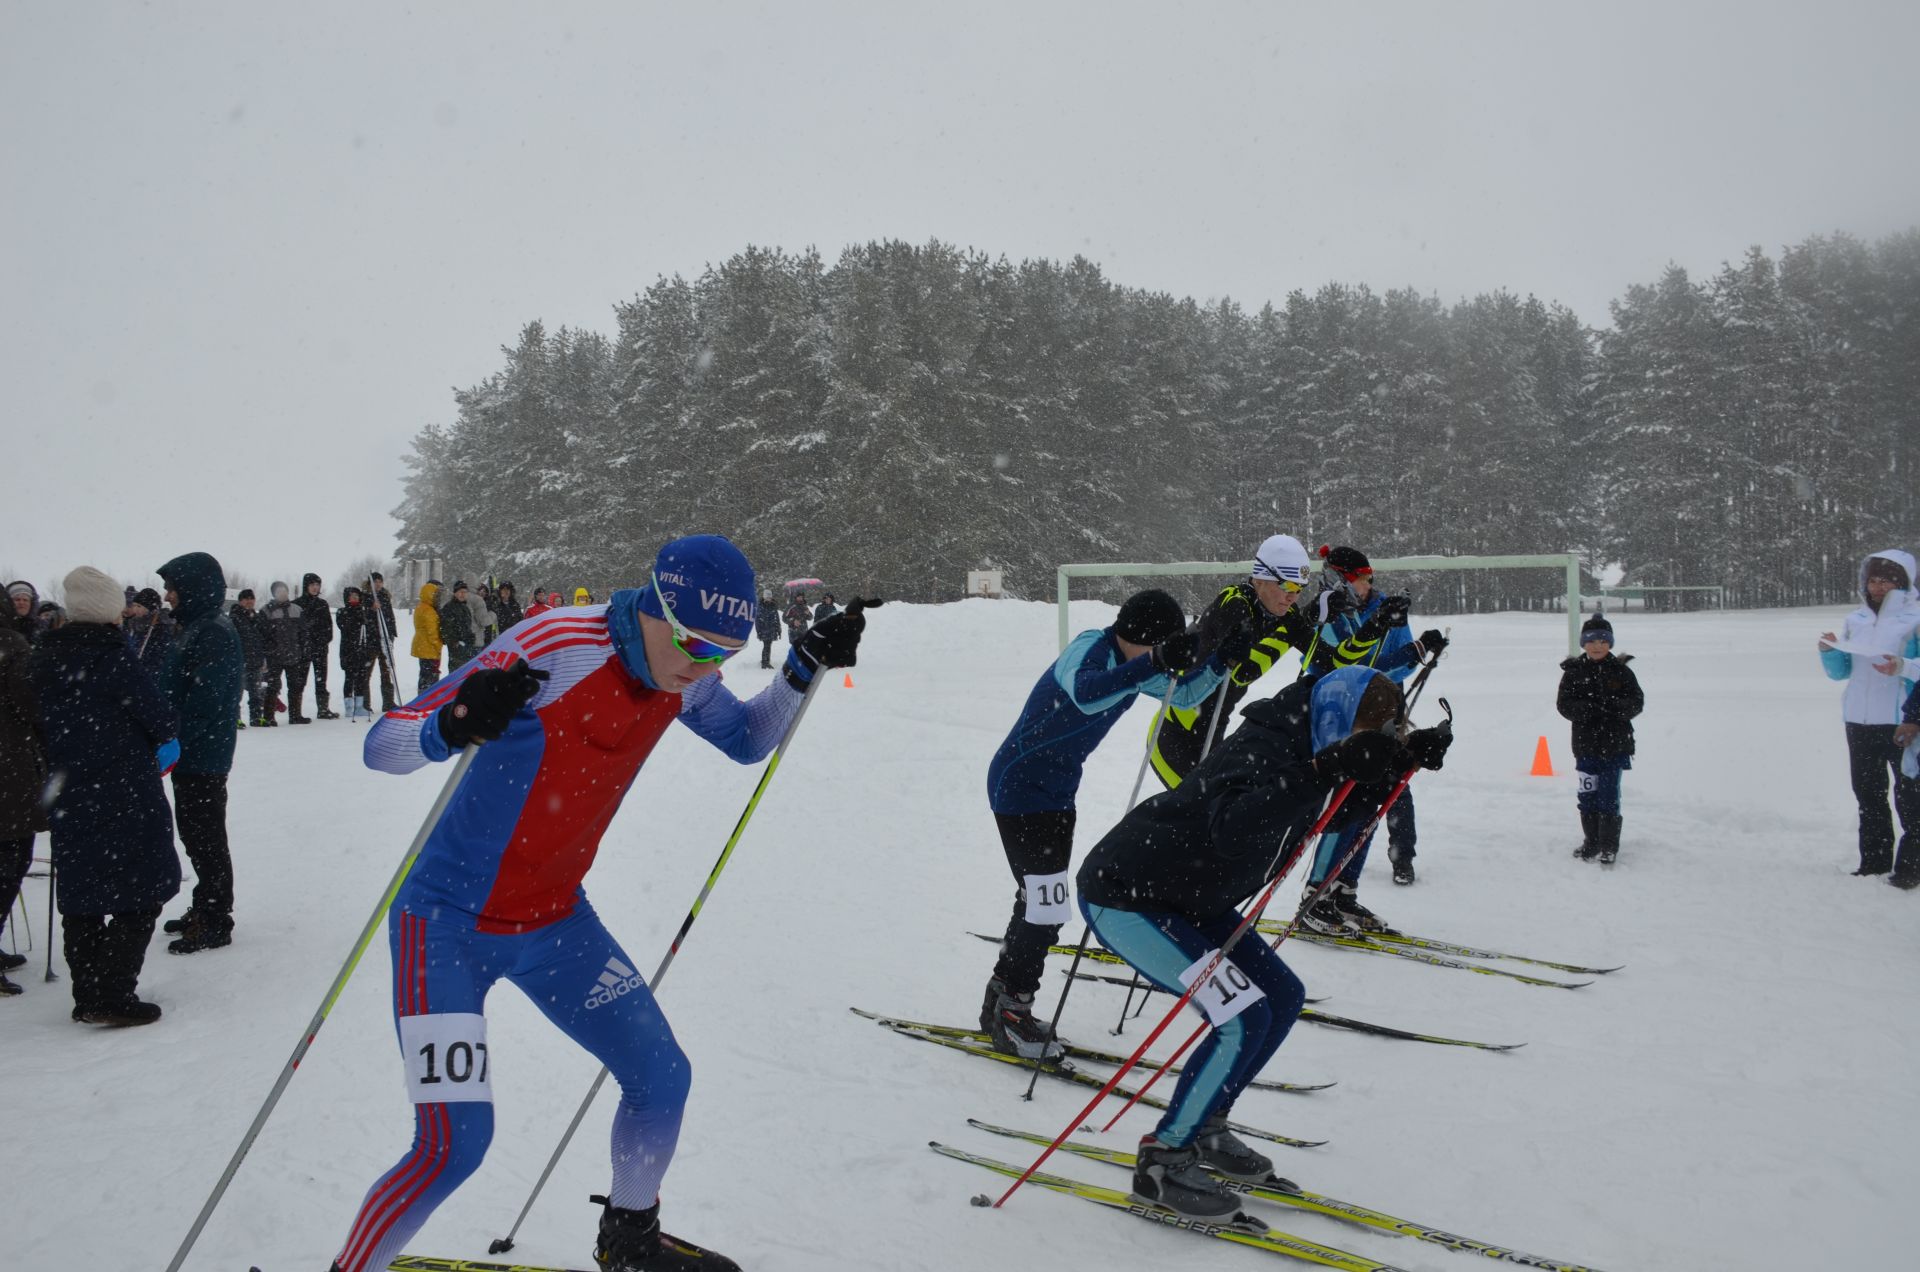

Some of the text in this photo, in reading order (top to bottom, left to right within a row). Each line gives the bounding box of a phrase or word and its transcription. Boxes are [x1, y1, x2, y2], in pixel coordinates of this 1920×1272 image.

[660, 571, 687, 587] VITAL
[1037, 882, 1069, 906] 10
[584, 974, 644, 1010] adidas
[419, 1041, 487, 1084] 107
[1126, 1203, 1222, 1238] FISCHER
